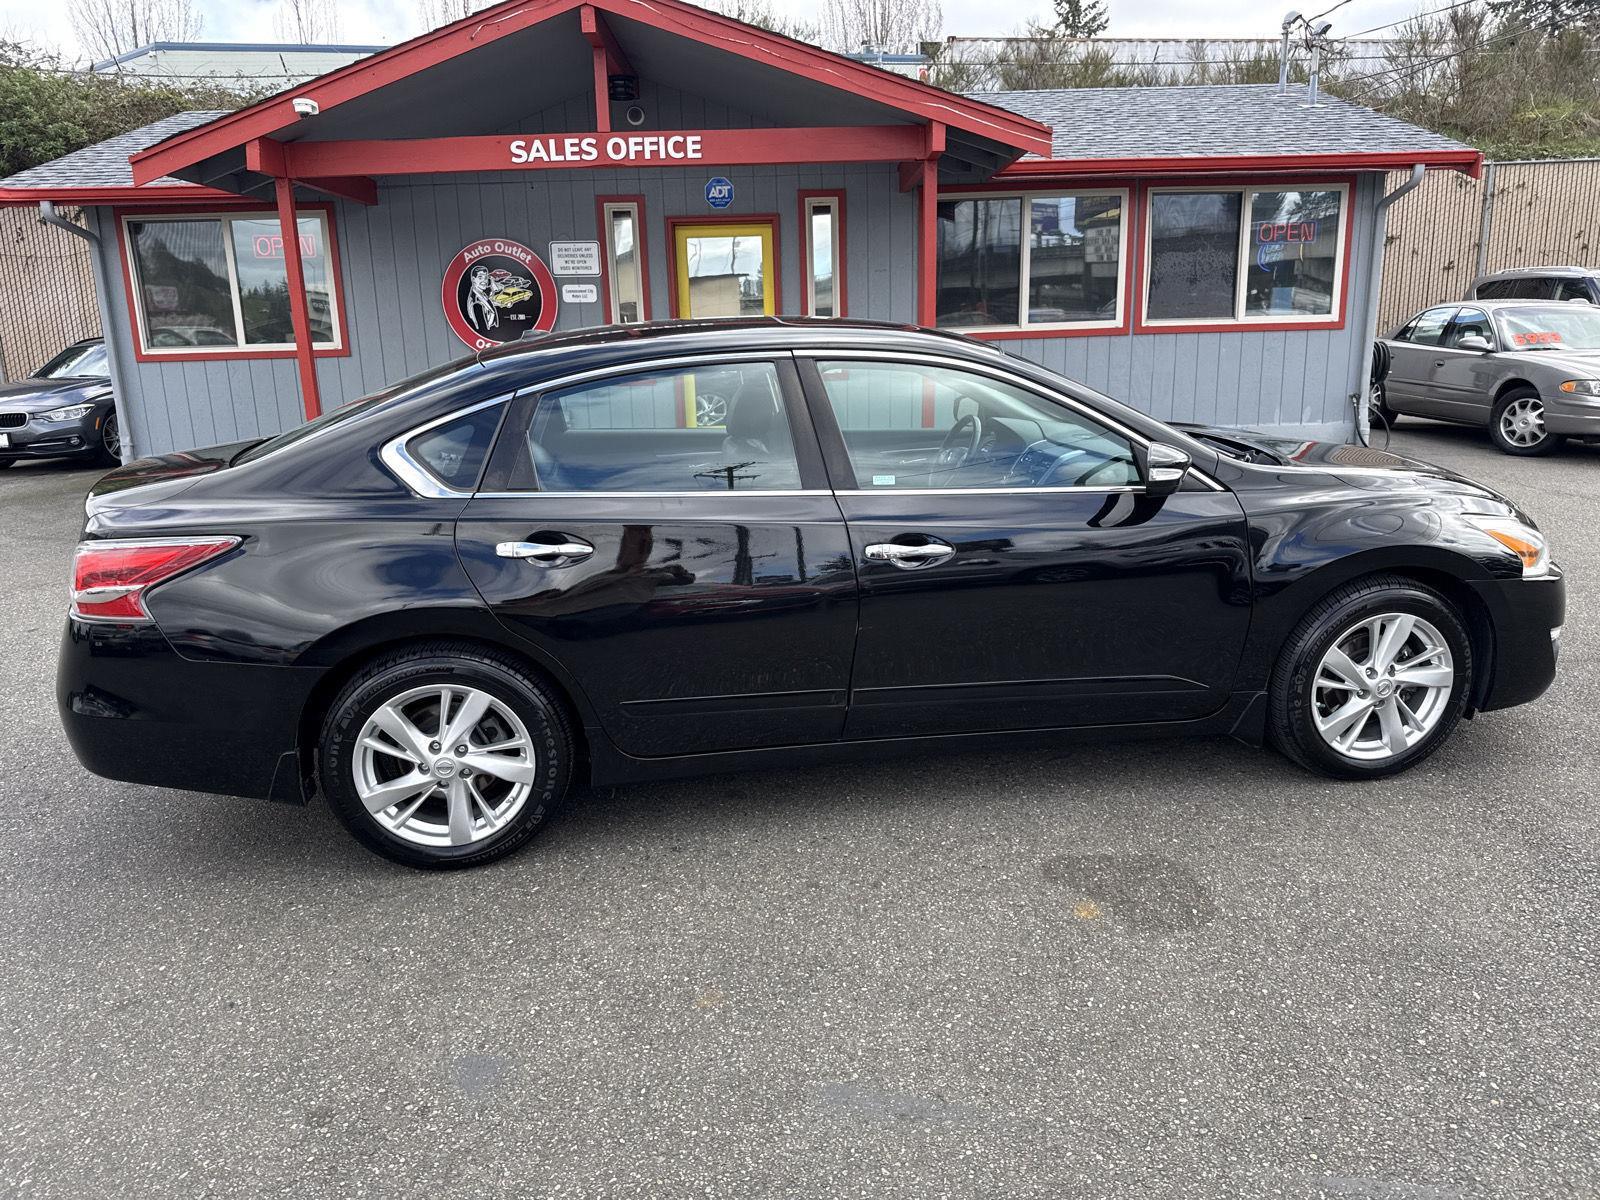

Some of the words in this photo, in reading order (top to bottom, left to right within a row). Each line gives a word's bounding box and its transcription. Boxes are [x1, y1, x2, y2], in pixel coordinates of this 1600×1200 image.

[509, 138, 598, 164] SALES
[606, 136, 703, 160] OFFICE
[709, 185, 731, 198] ADT
[1259, 223, 1315, 242] OPEN
[256, 237, 314, 256] OPN
[464, 245, 491, 263] Auto
[494, 242, 532, 264] Outlet
